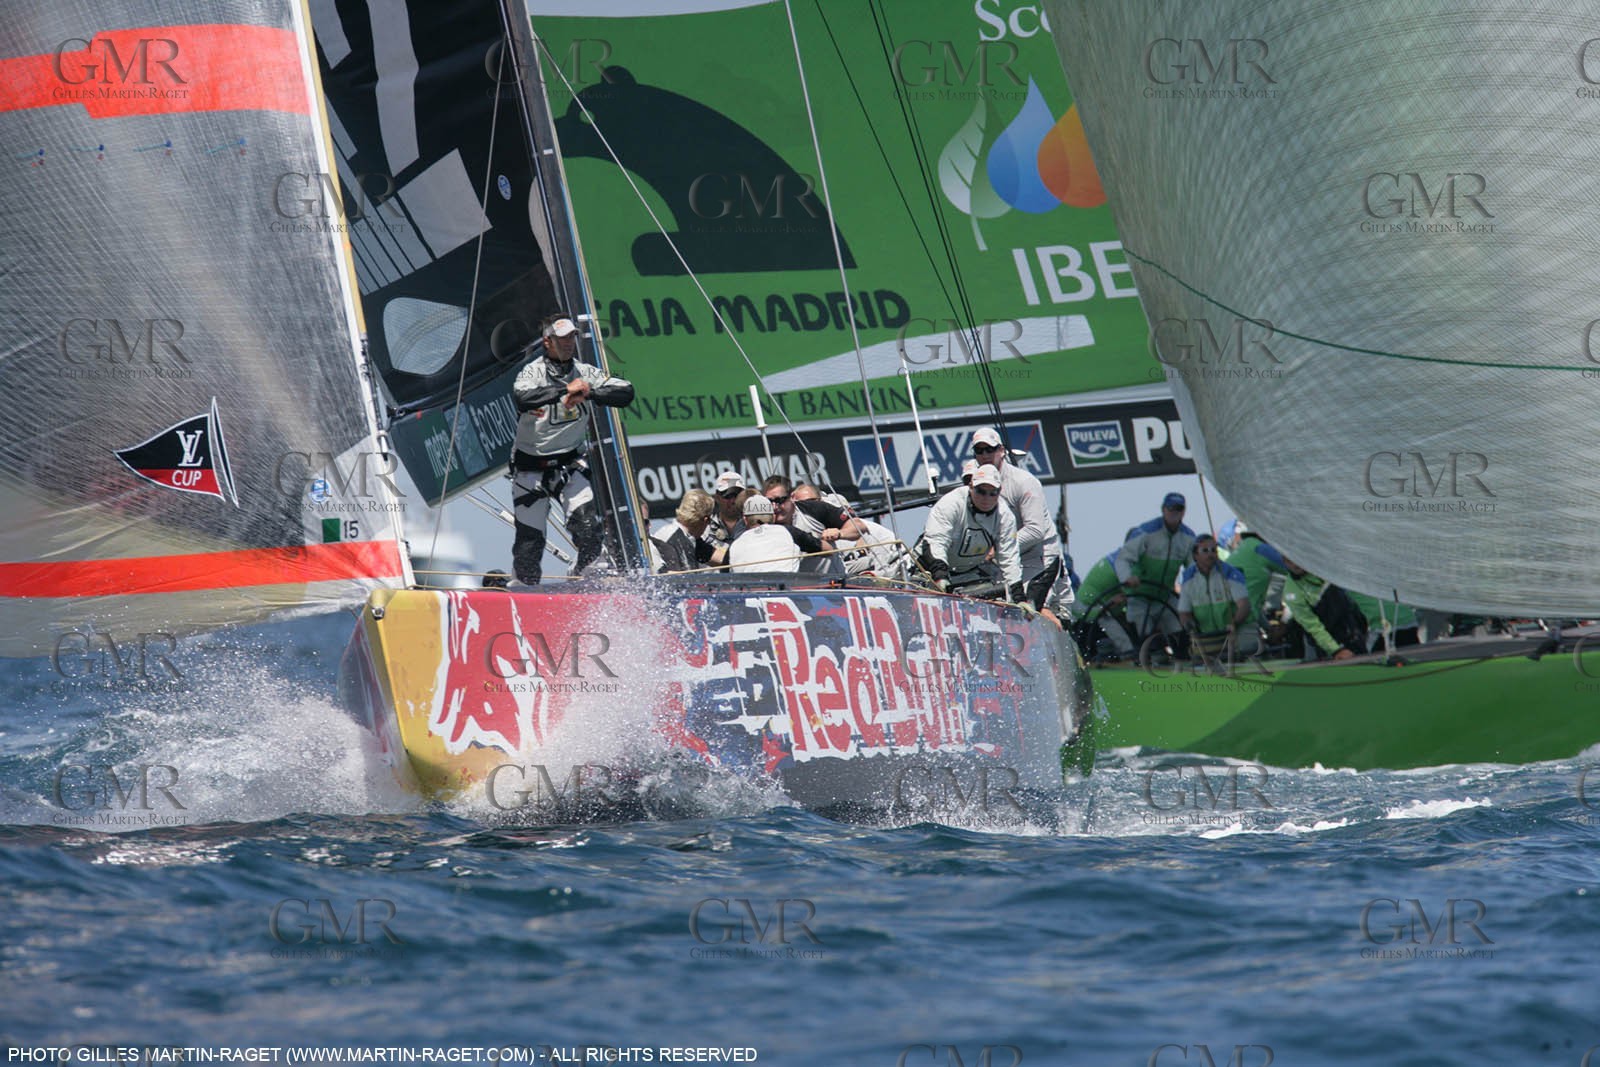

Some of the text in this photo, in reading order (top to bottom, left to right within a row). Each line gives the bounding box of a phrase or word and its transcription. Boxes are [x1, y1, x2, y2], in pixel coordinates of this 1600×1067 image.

[1012, 240, 1139, 305] IBE
[713, 289, 911, 333] MADRID
[622, 384, 937, 420] NVESTMENT BANKING
[1071, 428, 1118, 443] PULEVA
[171, 469, 202, 486] CUP
[343, 519, 359, 539] 15
